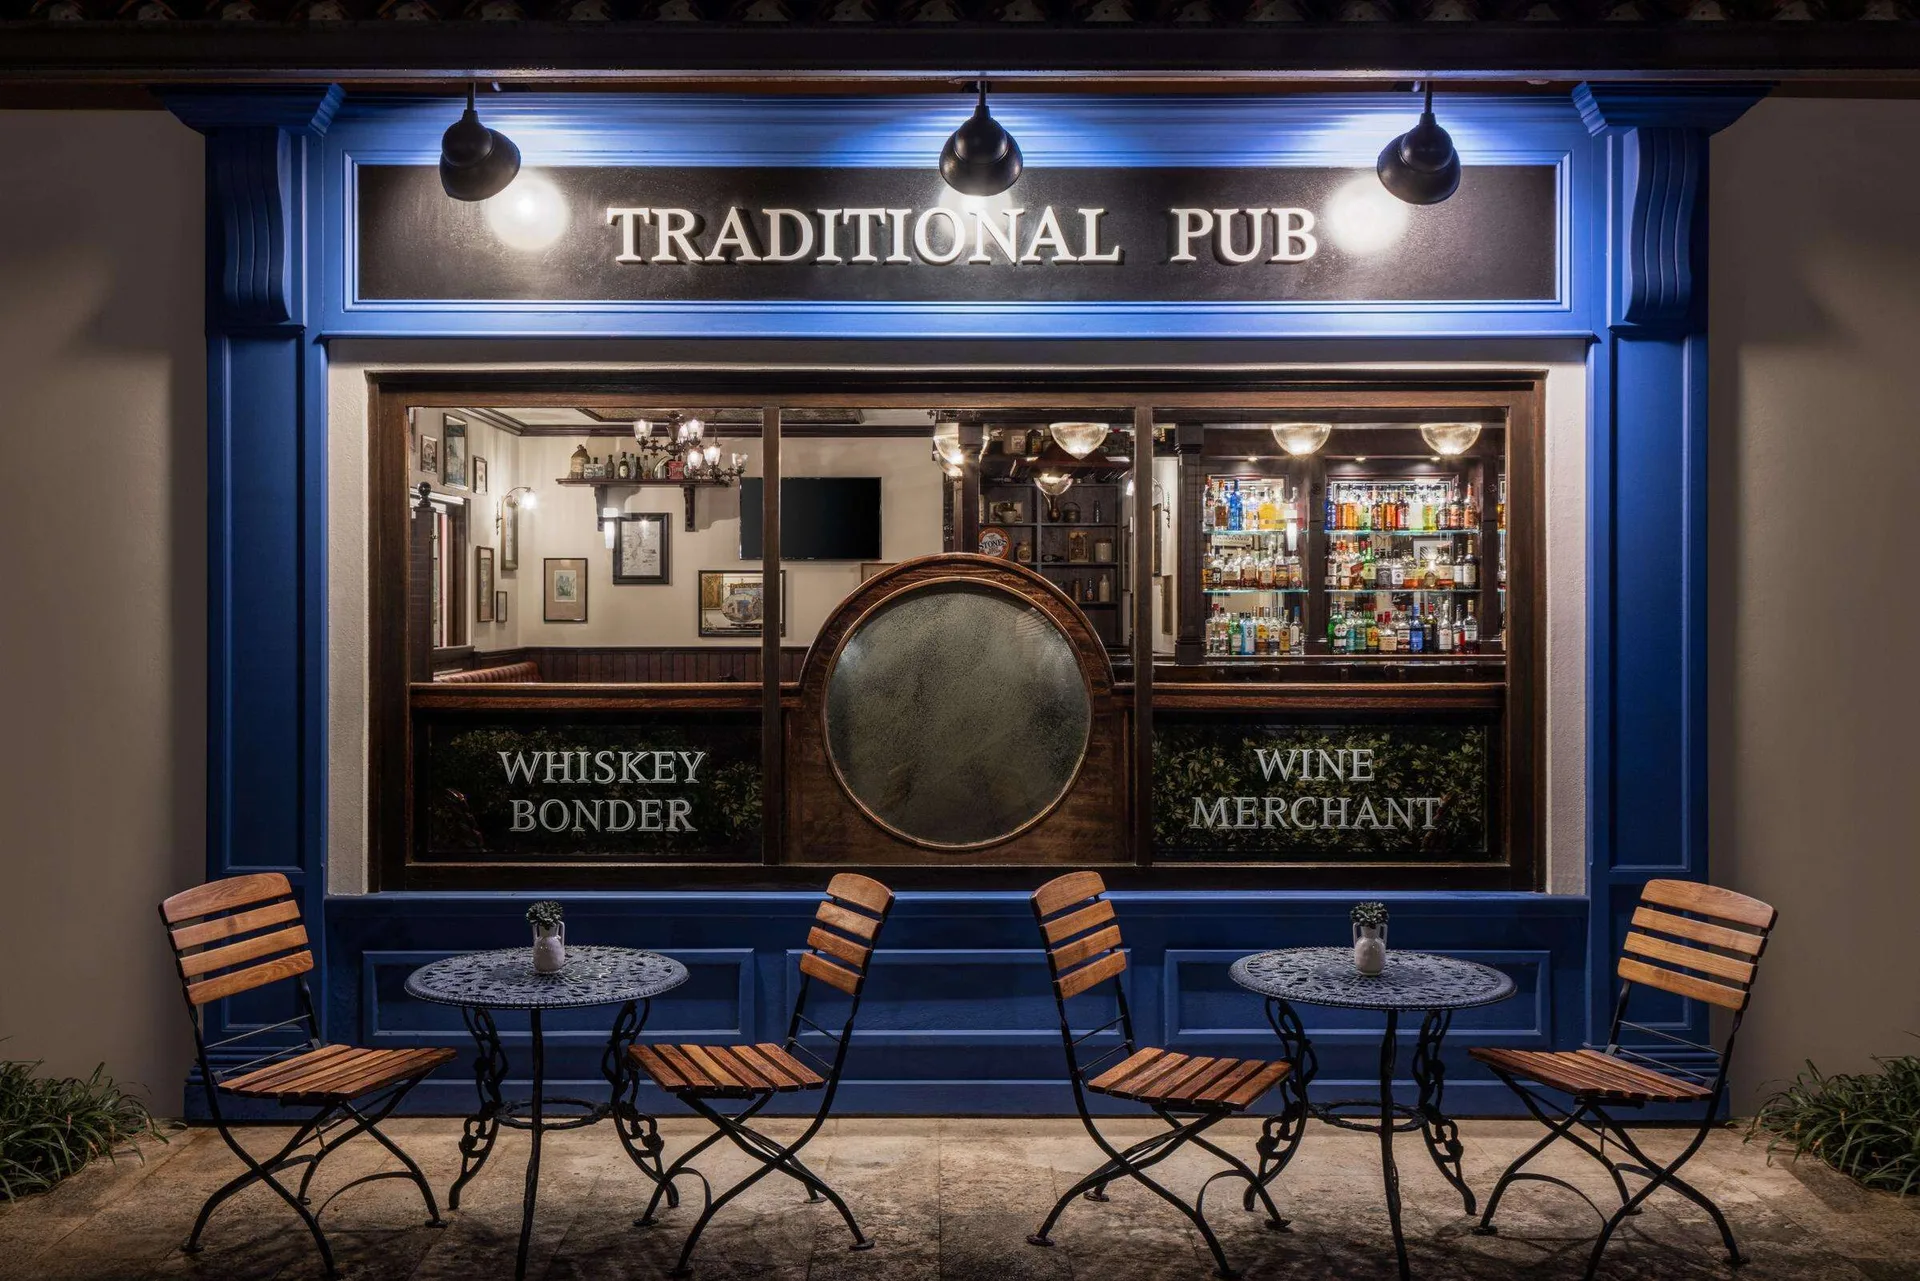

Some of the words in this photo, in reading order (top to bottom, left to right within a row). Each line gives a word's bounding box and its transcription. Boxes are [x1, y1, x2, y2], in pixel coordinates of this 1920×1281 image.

[606, 206, 1121, 264] TRADITIONAL
[1169, 207, 1319, 264] PUB
[497, 751, 706, 784] WHISKEY
[1254, 749, 1375, 782] WINE
[509, 799, 698, 832] BONDER
[1189, 796, 1442, 830] MERCHANT
